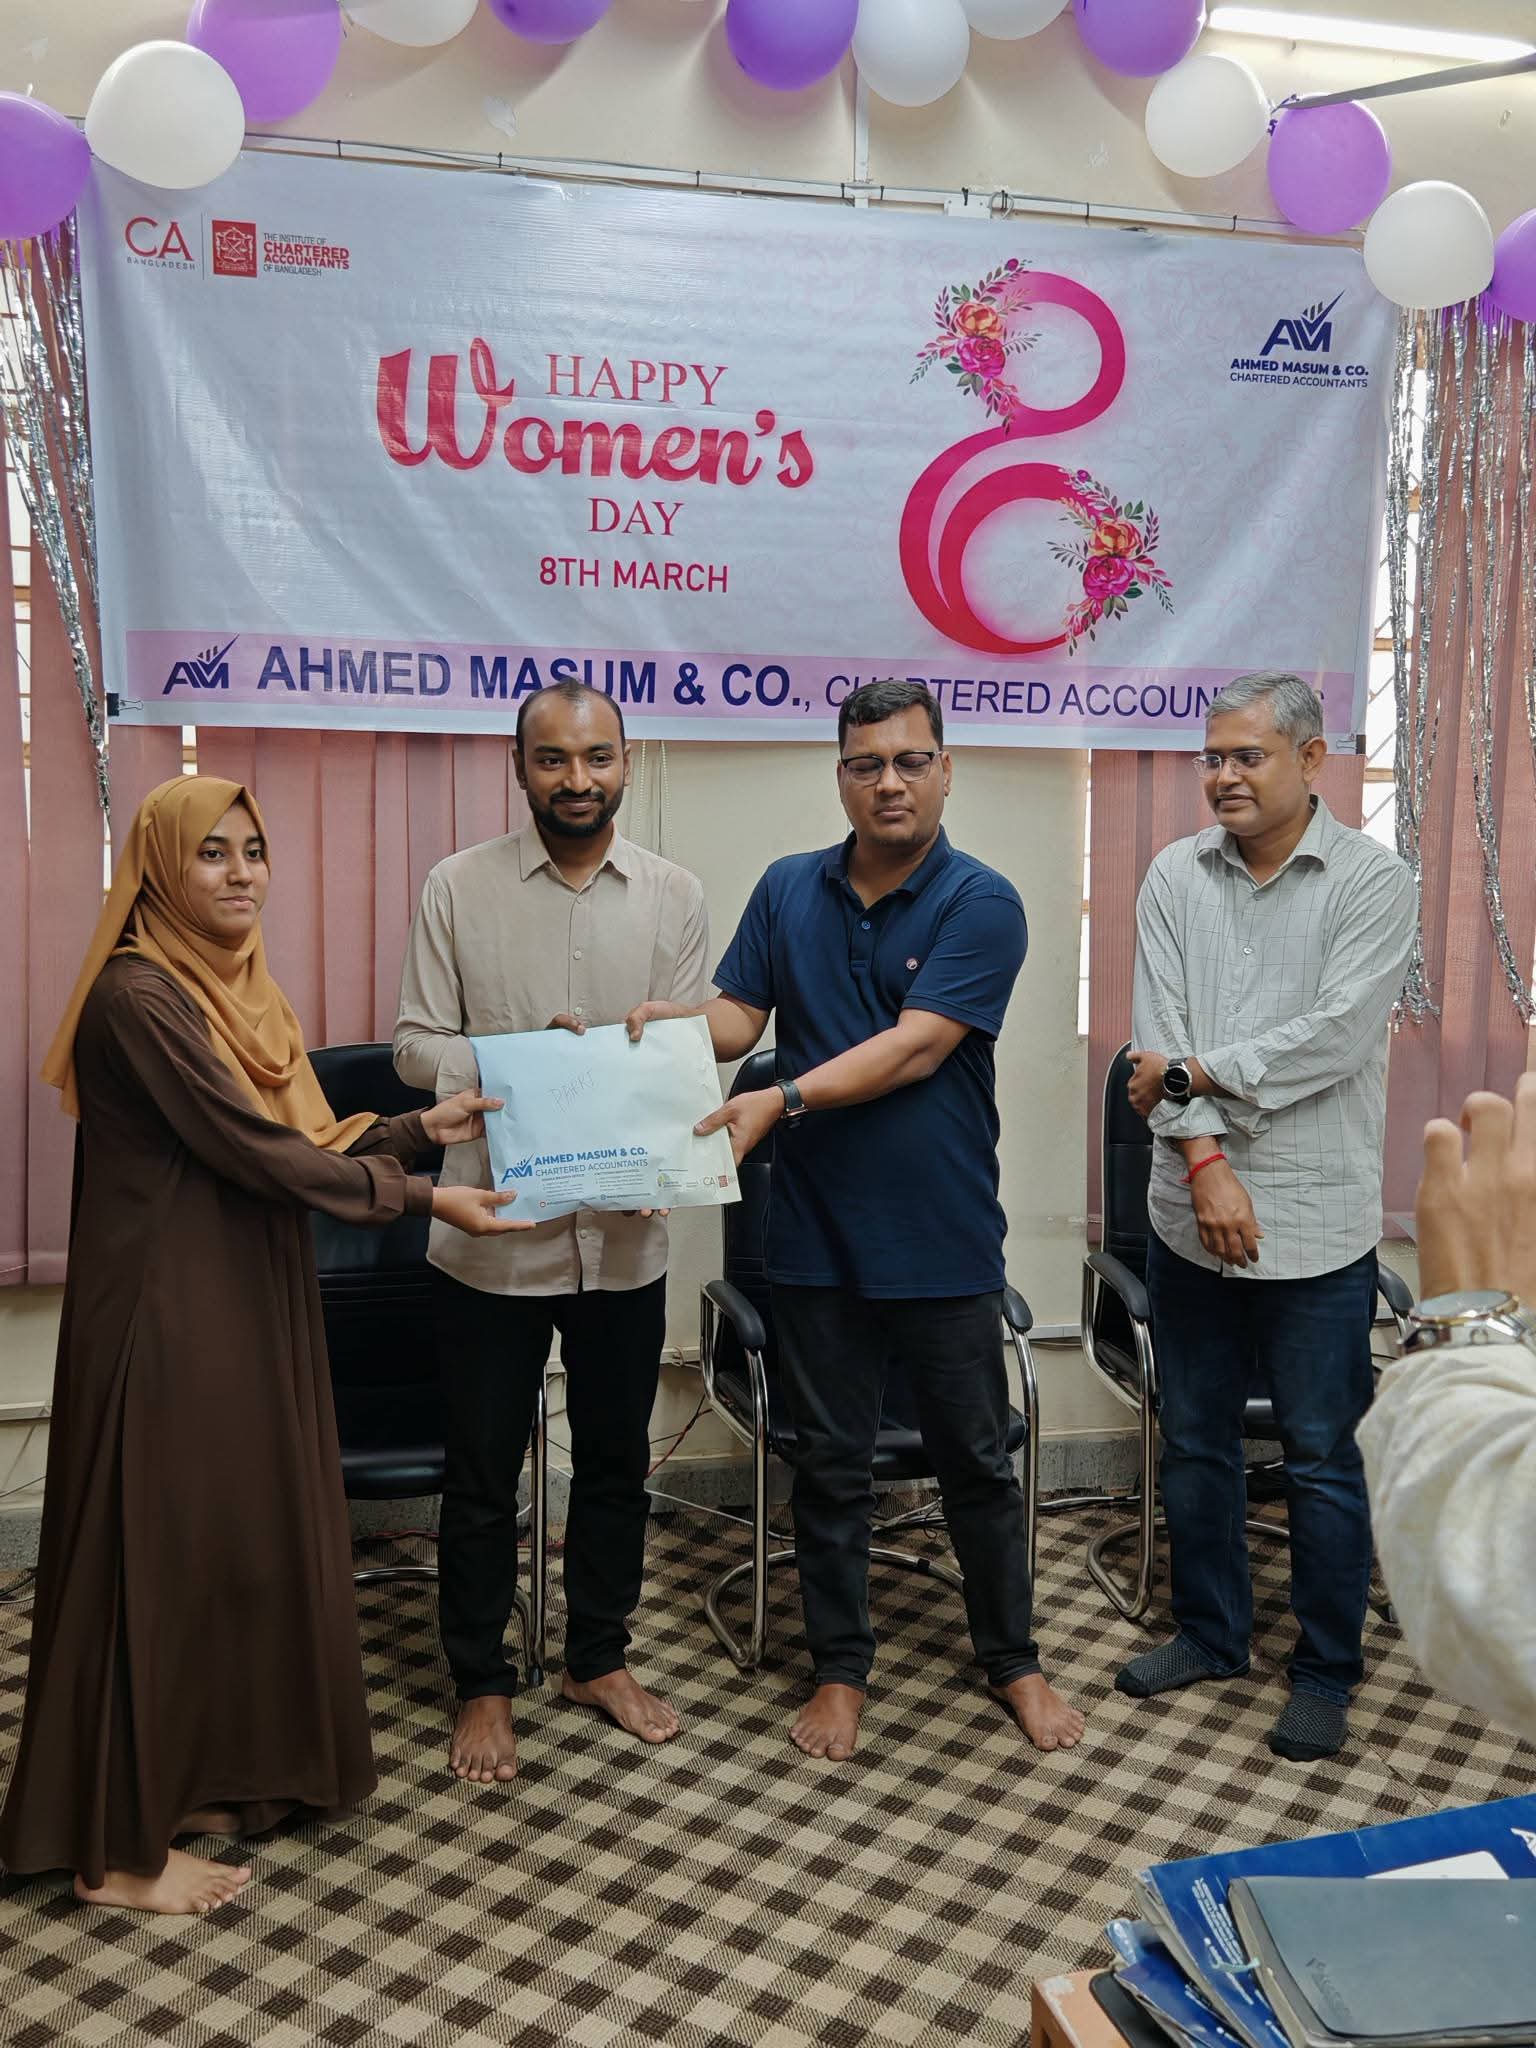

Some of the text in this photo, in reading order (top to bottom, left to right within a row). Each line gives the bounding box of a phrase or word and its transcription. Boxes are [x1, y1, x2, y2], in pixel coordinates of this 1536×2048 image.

[125, 216, 194, 261] CA
[263, 232, 278, 241] THE
[279, 234, 315, 244] INSTITUTE
[263, 241, 350, 260] CHARTERED
[126, 256, 196, 271] BANGLADESH
[263, 253, 350, 270] ACCOUNTANTS
[263, 264, 273, 273] OF
[275, 264, 322, 277] BANGLADESH
[1230, 358, 1369, 376] AHMED MASUM & CO.
[545, 353, 729, 406] HAPPY
[1230, 372, 1369, 388] CHARTERED ACCOUNTANTS
[587, 497, 685, 536] DAY
[538, 556, 729, 593] 8TH MARCH
[256, 645, 451, 696] AHMED
[673, 661, 706, 705] &
[825, 675, 1050, 716] CTERED
[534, 1146, 648, 1166] AHMED MASUM & CO.
[535, 1163, 586, 1177] CHARTERED
[587, 1158, 649, 1171] ACCOUNTANTS
